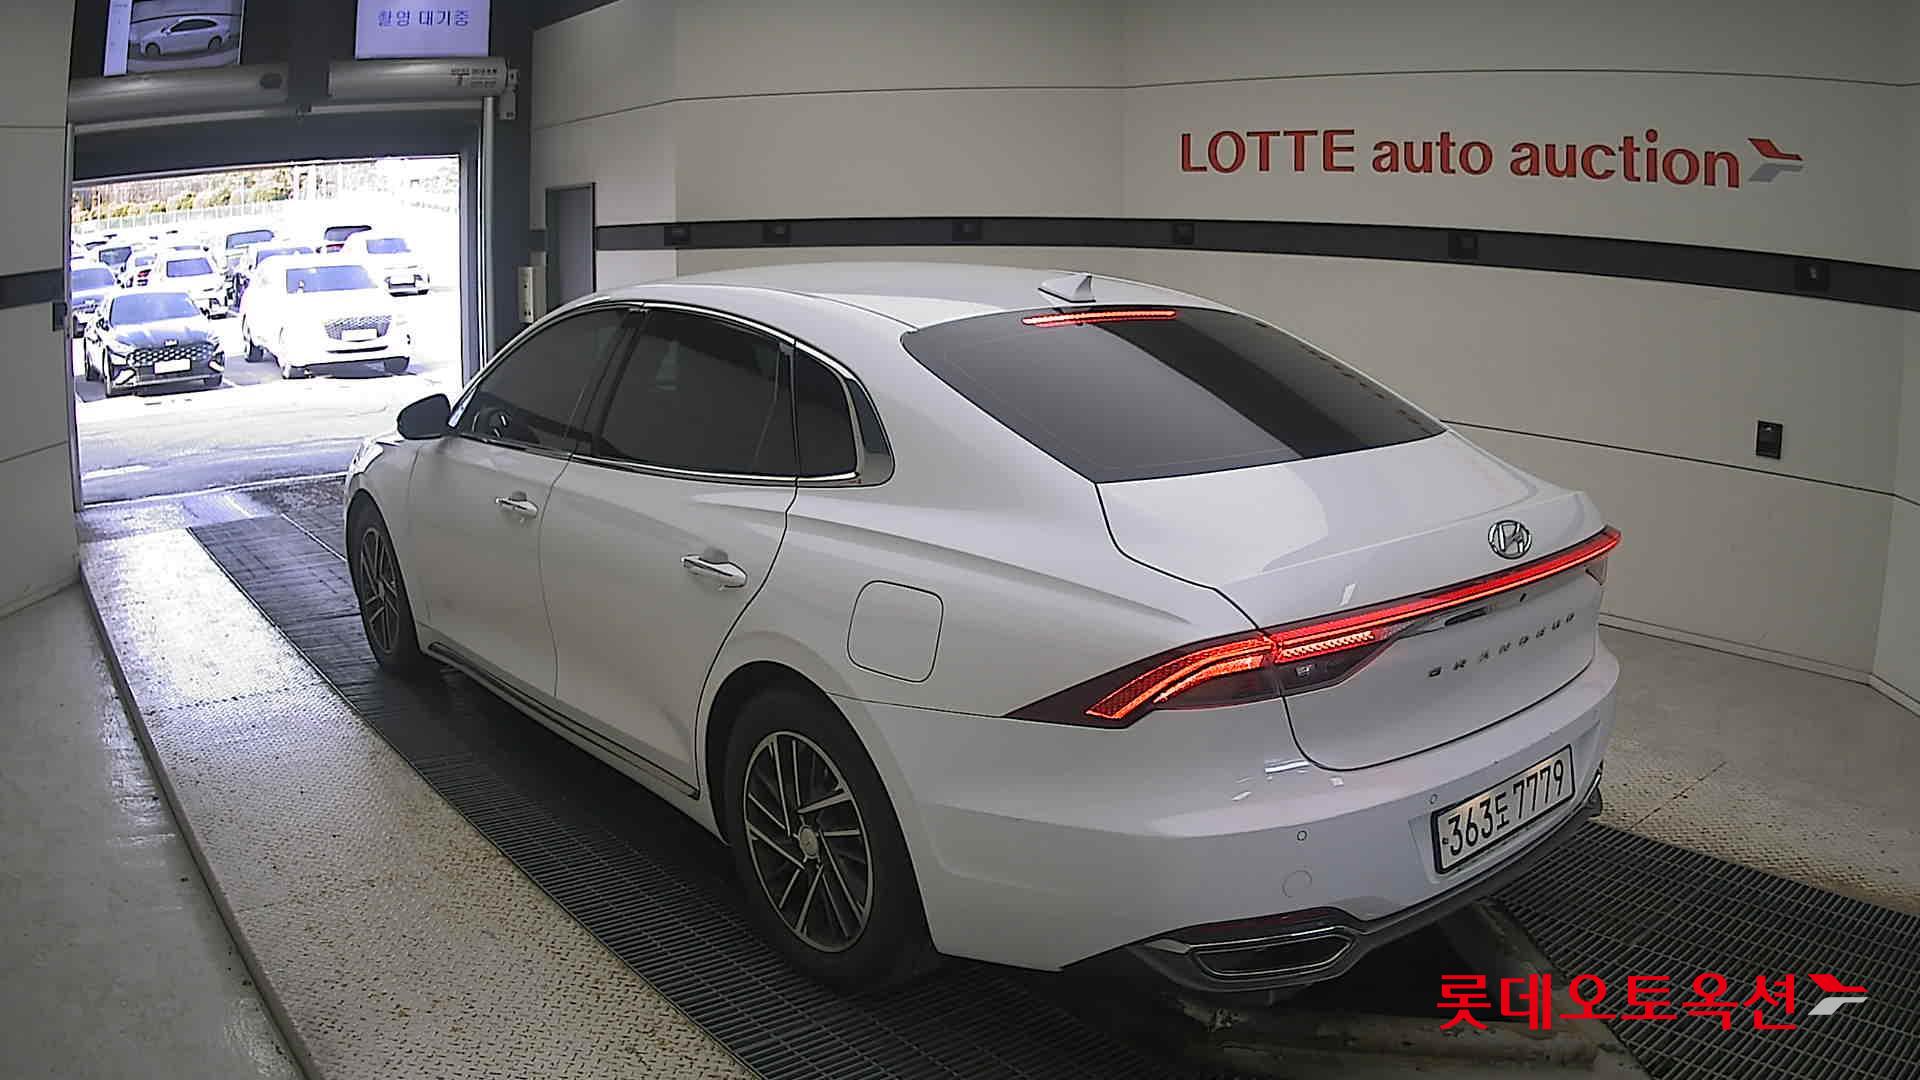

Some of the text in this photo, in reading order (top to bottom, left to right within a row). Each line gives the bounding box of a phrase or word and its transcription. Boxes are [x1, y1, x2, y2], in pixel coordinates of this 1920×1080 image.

[419, 9, 469, 27] 대기중
[1180, 129, 1741, 188] LOTTE auto auction
[1447, 759, 1564, 856] 363도7779
